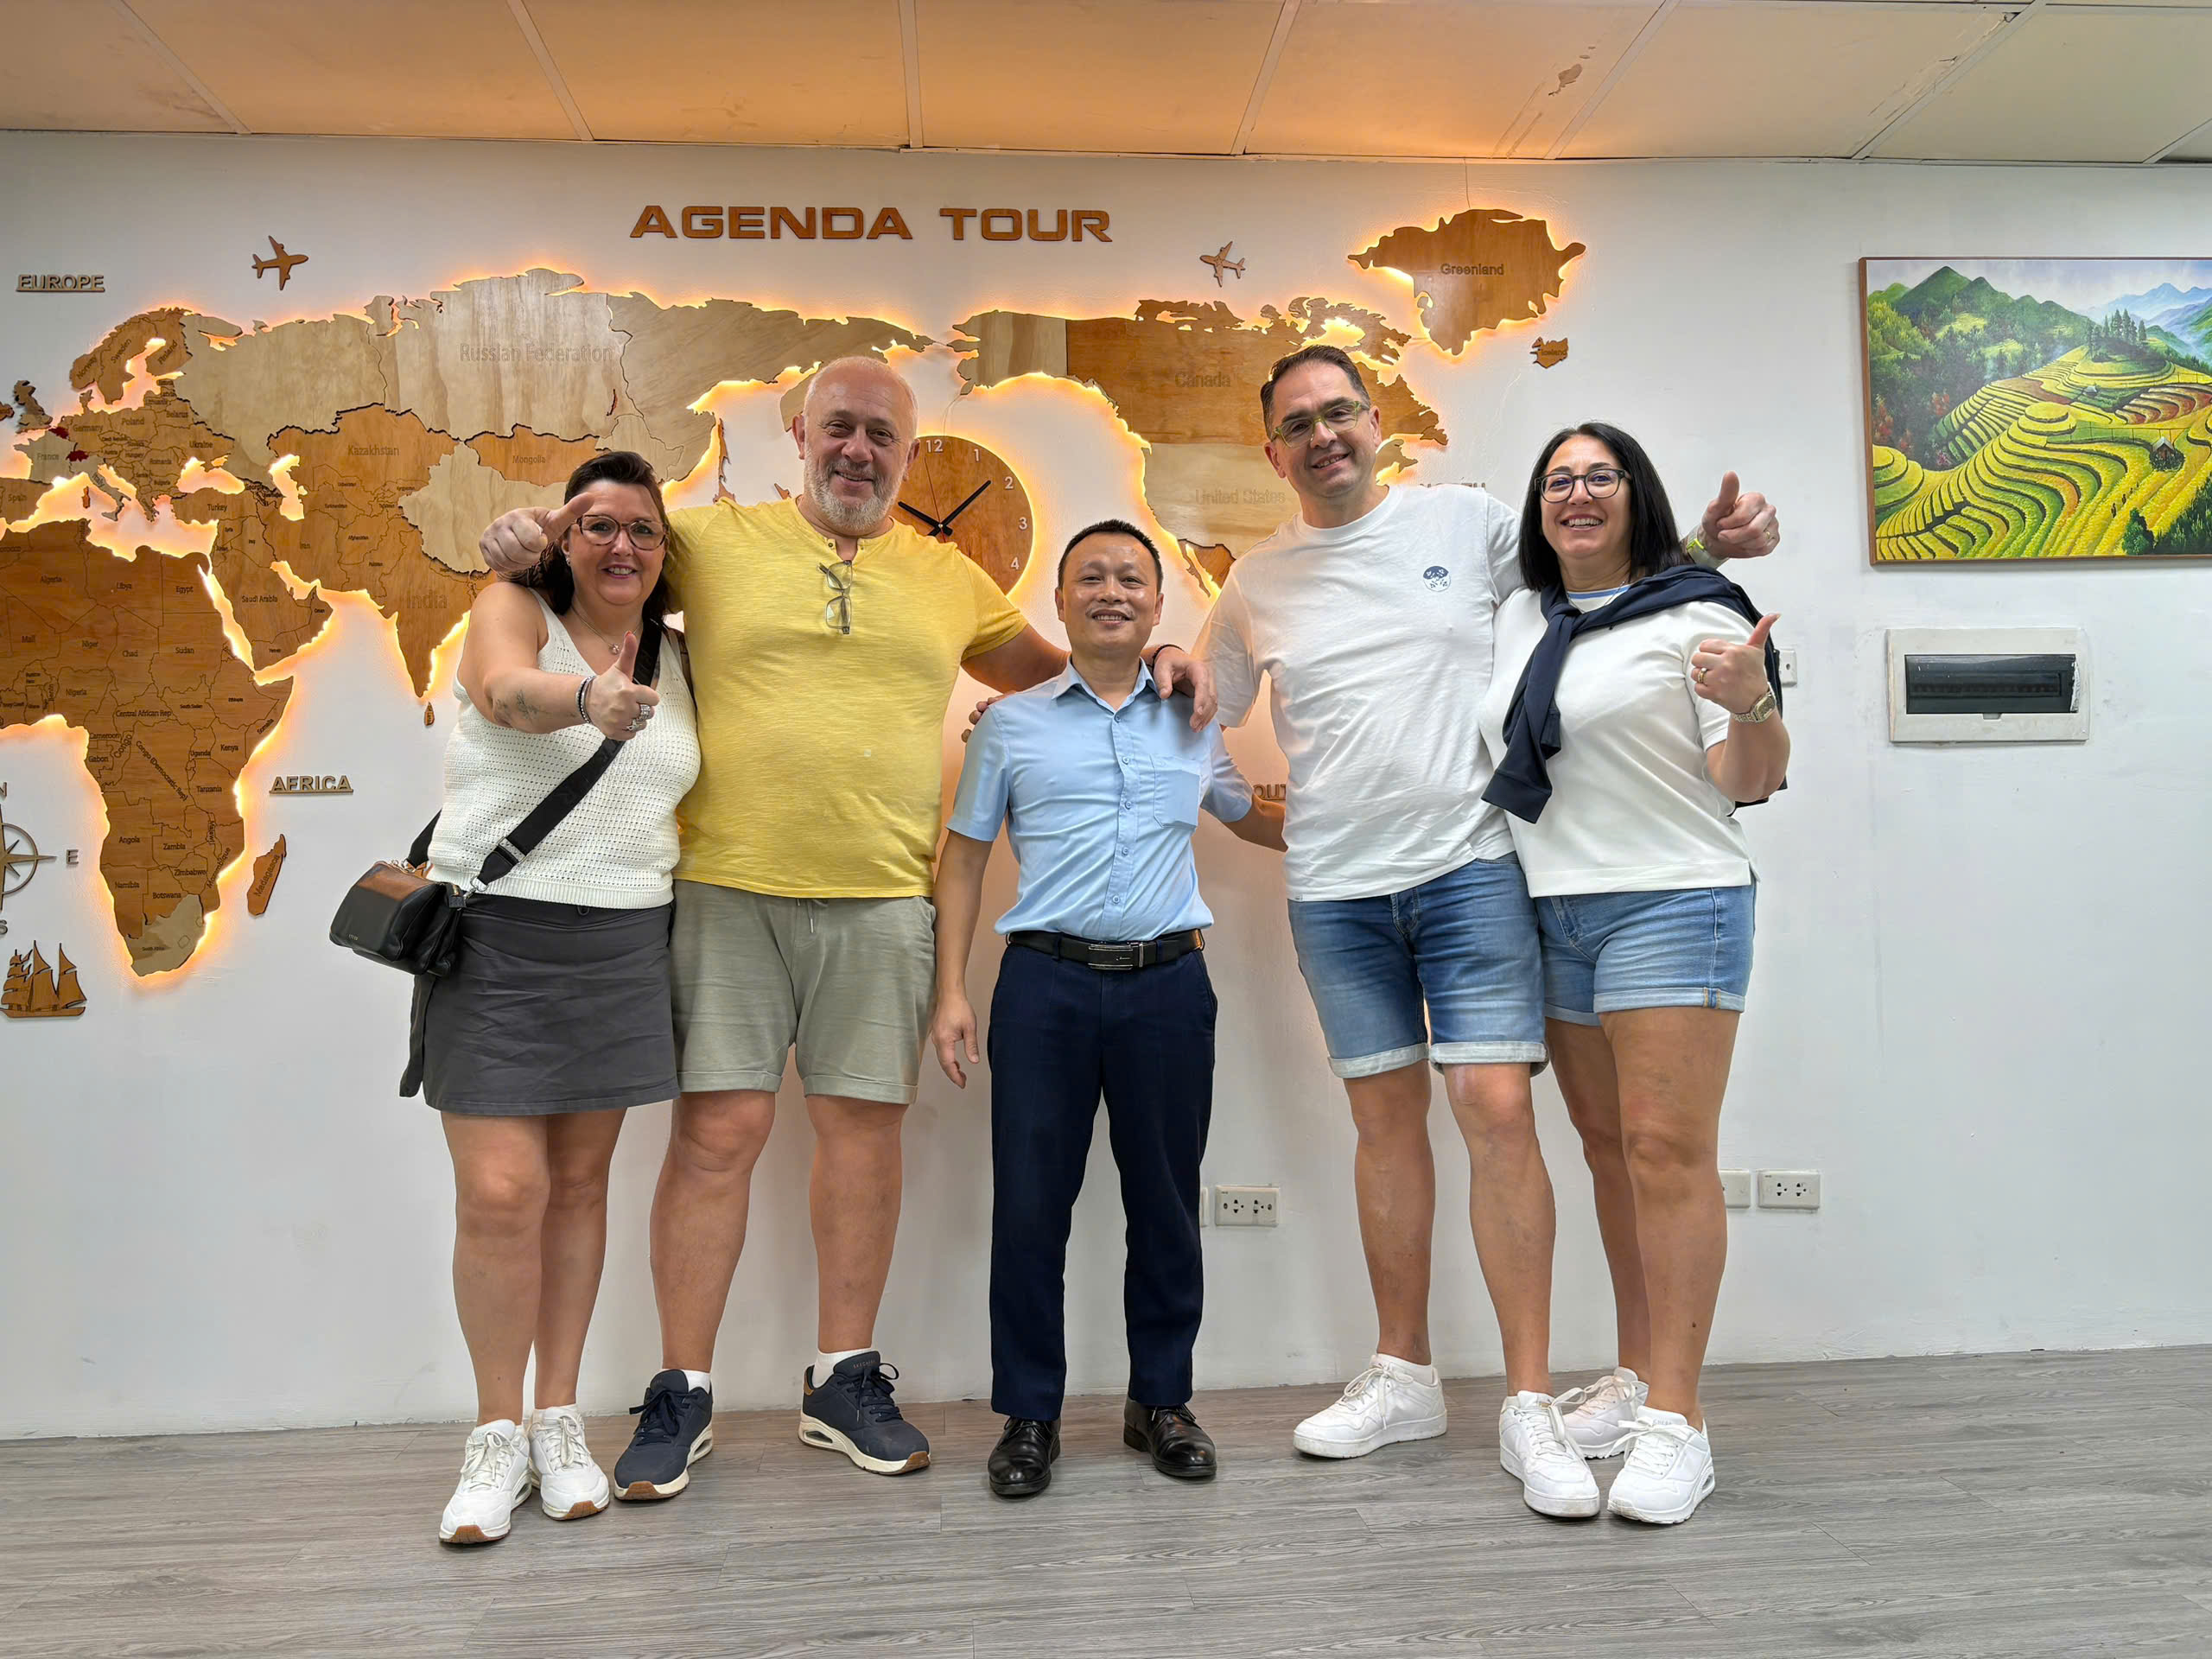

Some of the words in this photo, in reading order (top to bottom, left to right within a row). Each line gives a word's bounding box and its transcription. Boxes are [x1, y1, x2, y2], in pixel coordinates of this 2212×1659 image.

[629, 205, 913, 240] AGENDA
[938, 207, 1113, 242] TOUR
[1440, 263, 1504, 276] Greenland
[17, 274, 105, 291] EUROPE
[110, 338, 132, 364] Sweden
[157, 340, 178, 365] Finland
[461, 342, 521, 362] Russian
[525, 342, 613, 362] Federation
[77, 356, 98, 379] Norway
[1174, 371, 1231, 388] Canada
[121, 417, 145, 426] Poland
[73, 424, 104, 433] Germany
[347, 444, 399, 456] Kazakhstan
[925, 439, 944, 453] 12
[512, 454, 546, 466] Mongolia
[974, 448, 981, 461] 1
[1004, 476, 1014, 490] 2
[8, 493, 28, 502] Spain
[1195, 488, 1238, 505] United
[1243, 488, 1286, 505] States
[207, 503, 228, 512] Turkey
[1018, 517, 1027, 530] 3
[299, 541, 311, 550] Iran
[1009, 556, 1020, 570] 4
[40, 575, 62, 584] Algeria
[116, 582, 132, 591] Libya
[175, 586, 194, 594] Egypt
[406, 590, 448, 609] India
[81, 639, 99, 648] Niger
[159, 709, 172, 718] Rep
[113, 734, 133, 759] Congo
[135, 741, 151, 760] Congo
[220, 743, 239, 752] Kenya
[189, 749, 212, 758] Uganda
[270, 775, 353, 792] AFRICA
[66, 849, 79, 865] E
